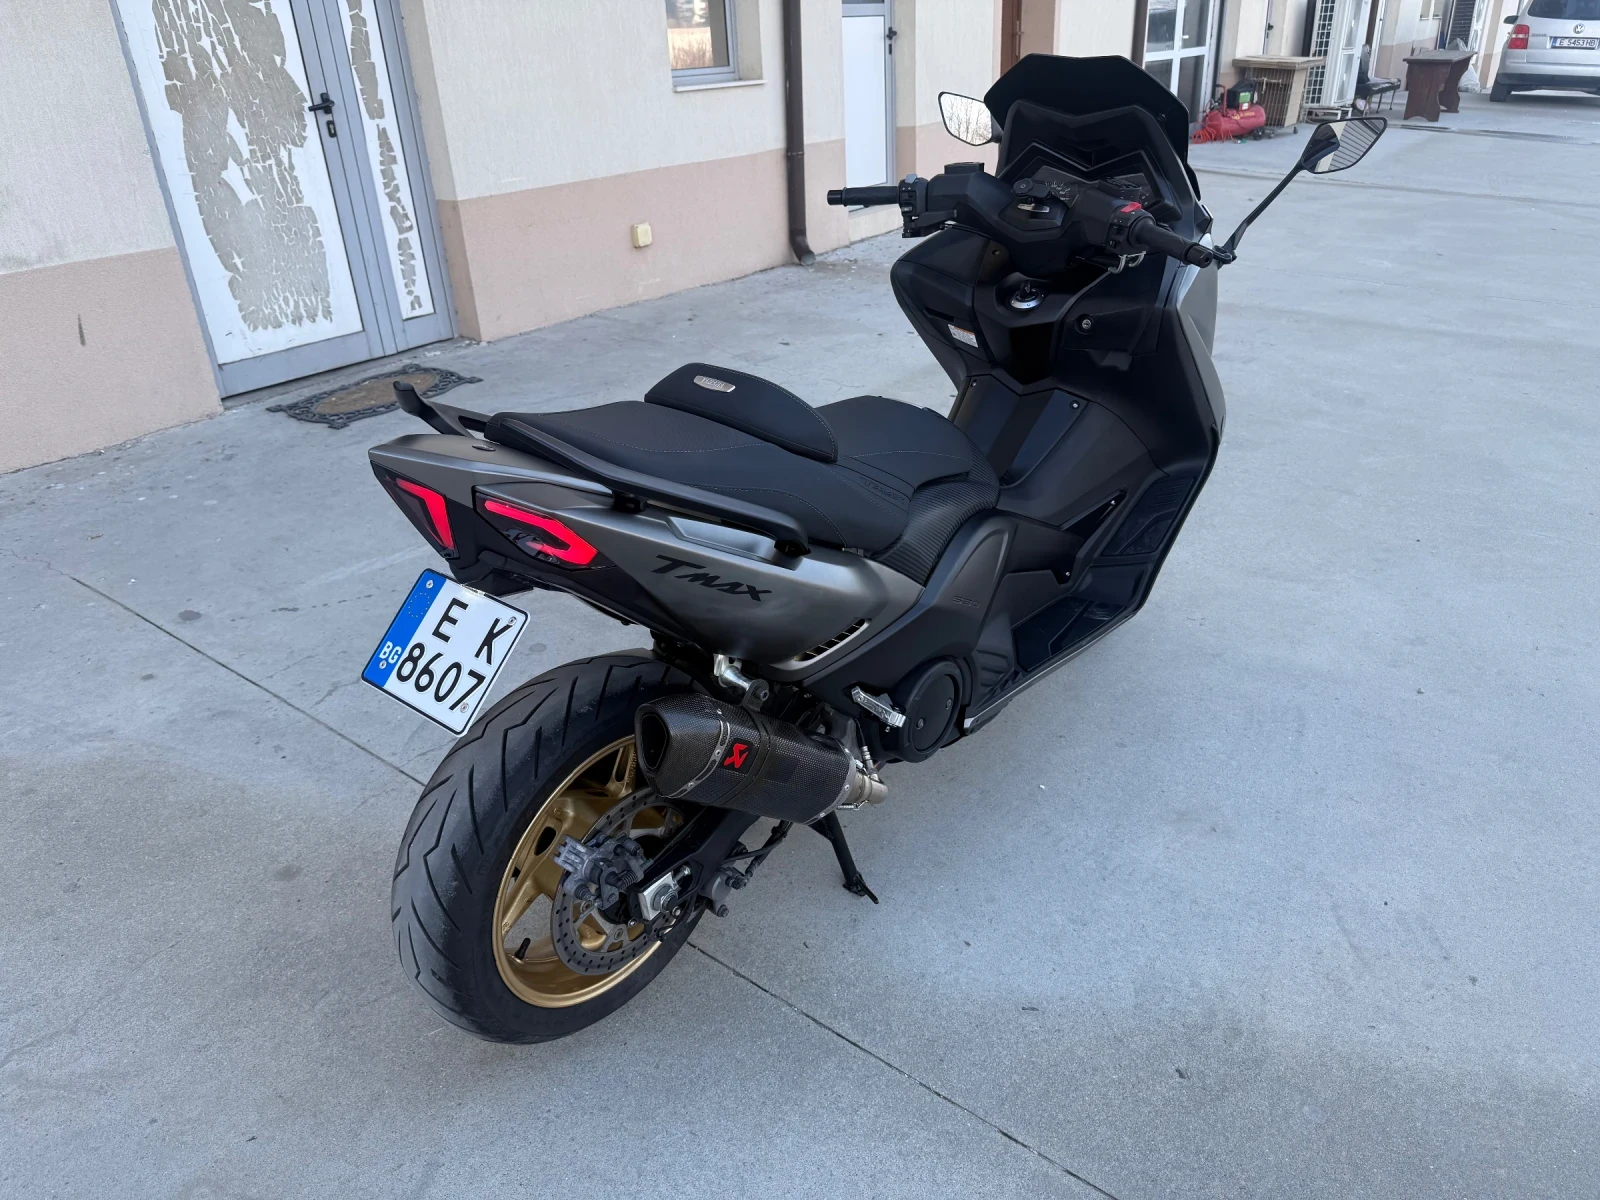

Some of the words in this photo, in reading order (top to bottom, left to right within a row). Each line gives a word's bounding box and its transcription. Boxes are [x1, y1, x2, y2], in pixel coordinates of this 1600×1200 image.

[1559, 38, 1565, 46] E
[651, 554, 772, 602] TMAX
[379, 641, 402, 664] BG
[432, 597, 469, 643] E
[474, 617, 513, 666] K
[396, 642, 487, 711] 8607
